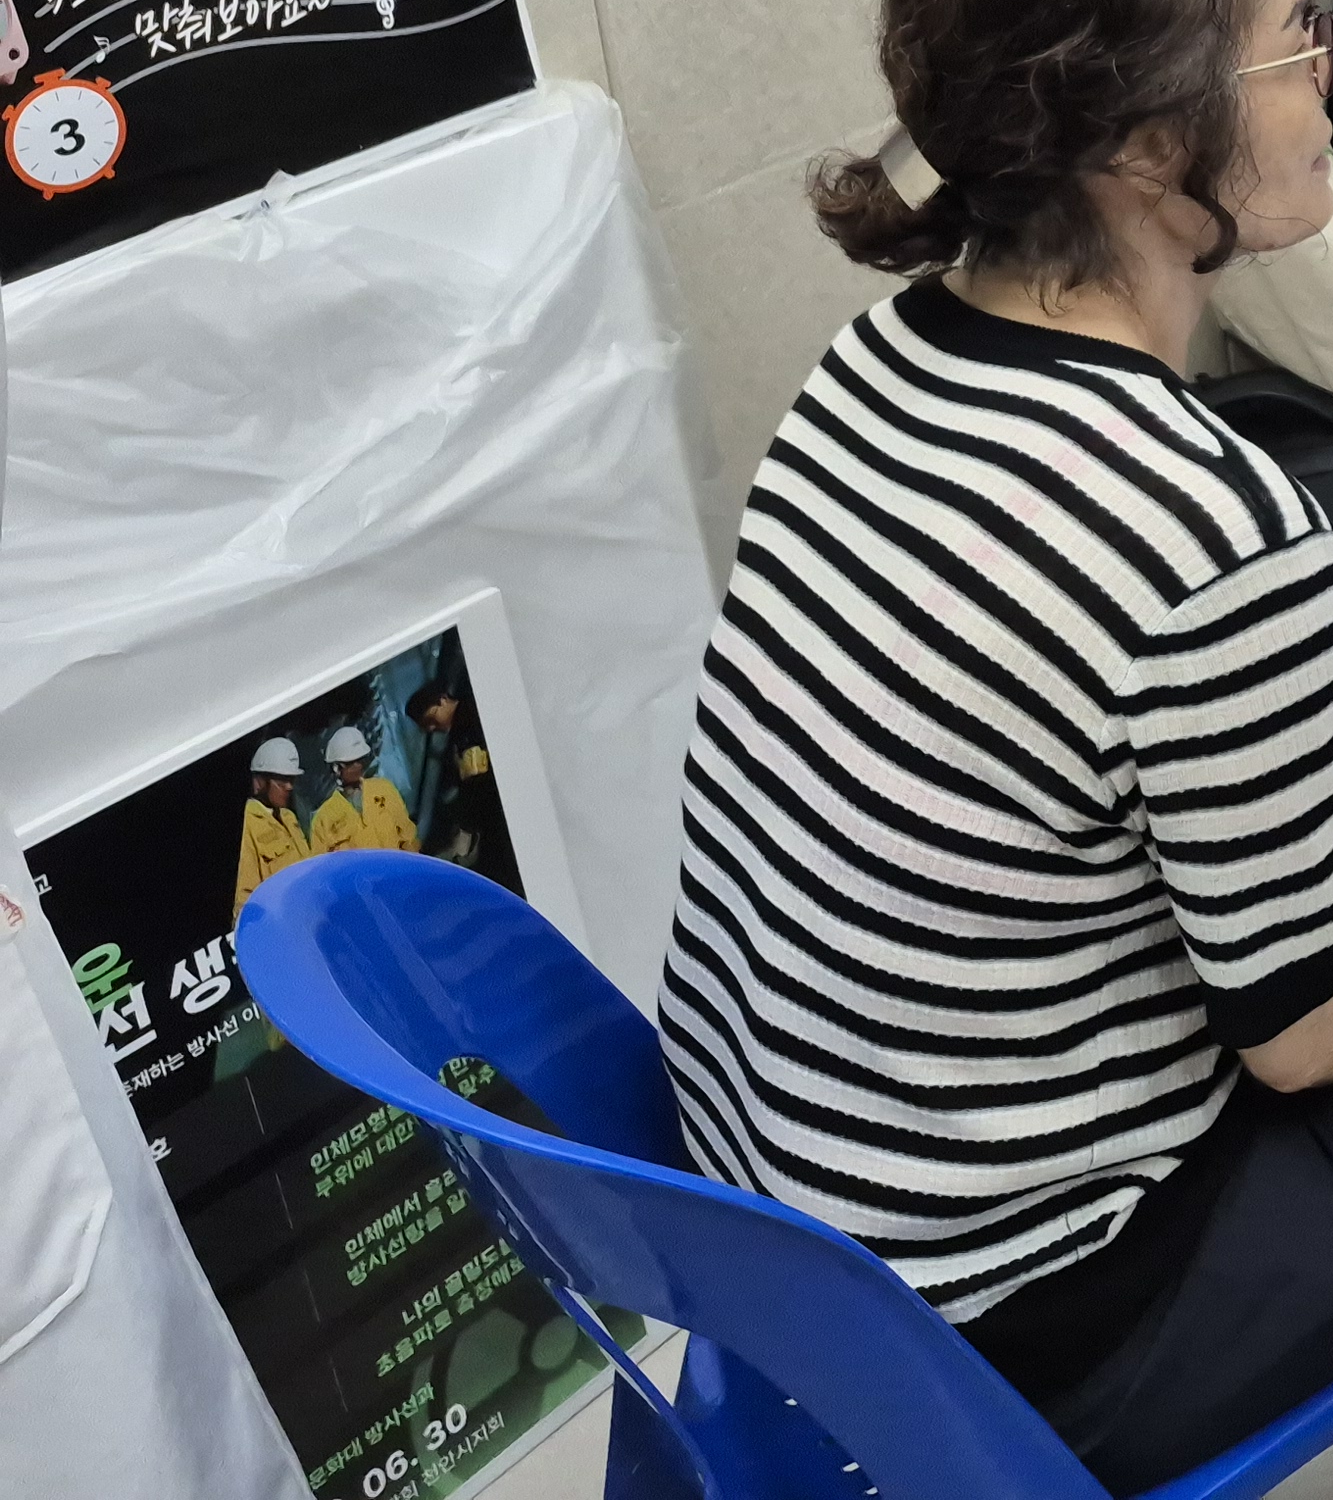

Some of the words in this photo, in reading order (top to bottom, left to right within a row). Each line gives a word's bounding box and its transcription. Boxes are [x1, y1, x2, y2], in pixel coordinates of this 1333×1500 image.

[50, 118, 85, 156] 3
[170, 931, 237, 1014] 생
[187, 1015, 239, 1057] 방사선
[345, 1192, 422, 1260] 인체에서
[402, 1285, 442, 1325] 나의
[364, 1382, 434, 1445] 방사선과
[422, 1403, 467, 1450] 30
